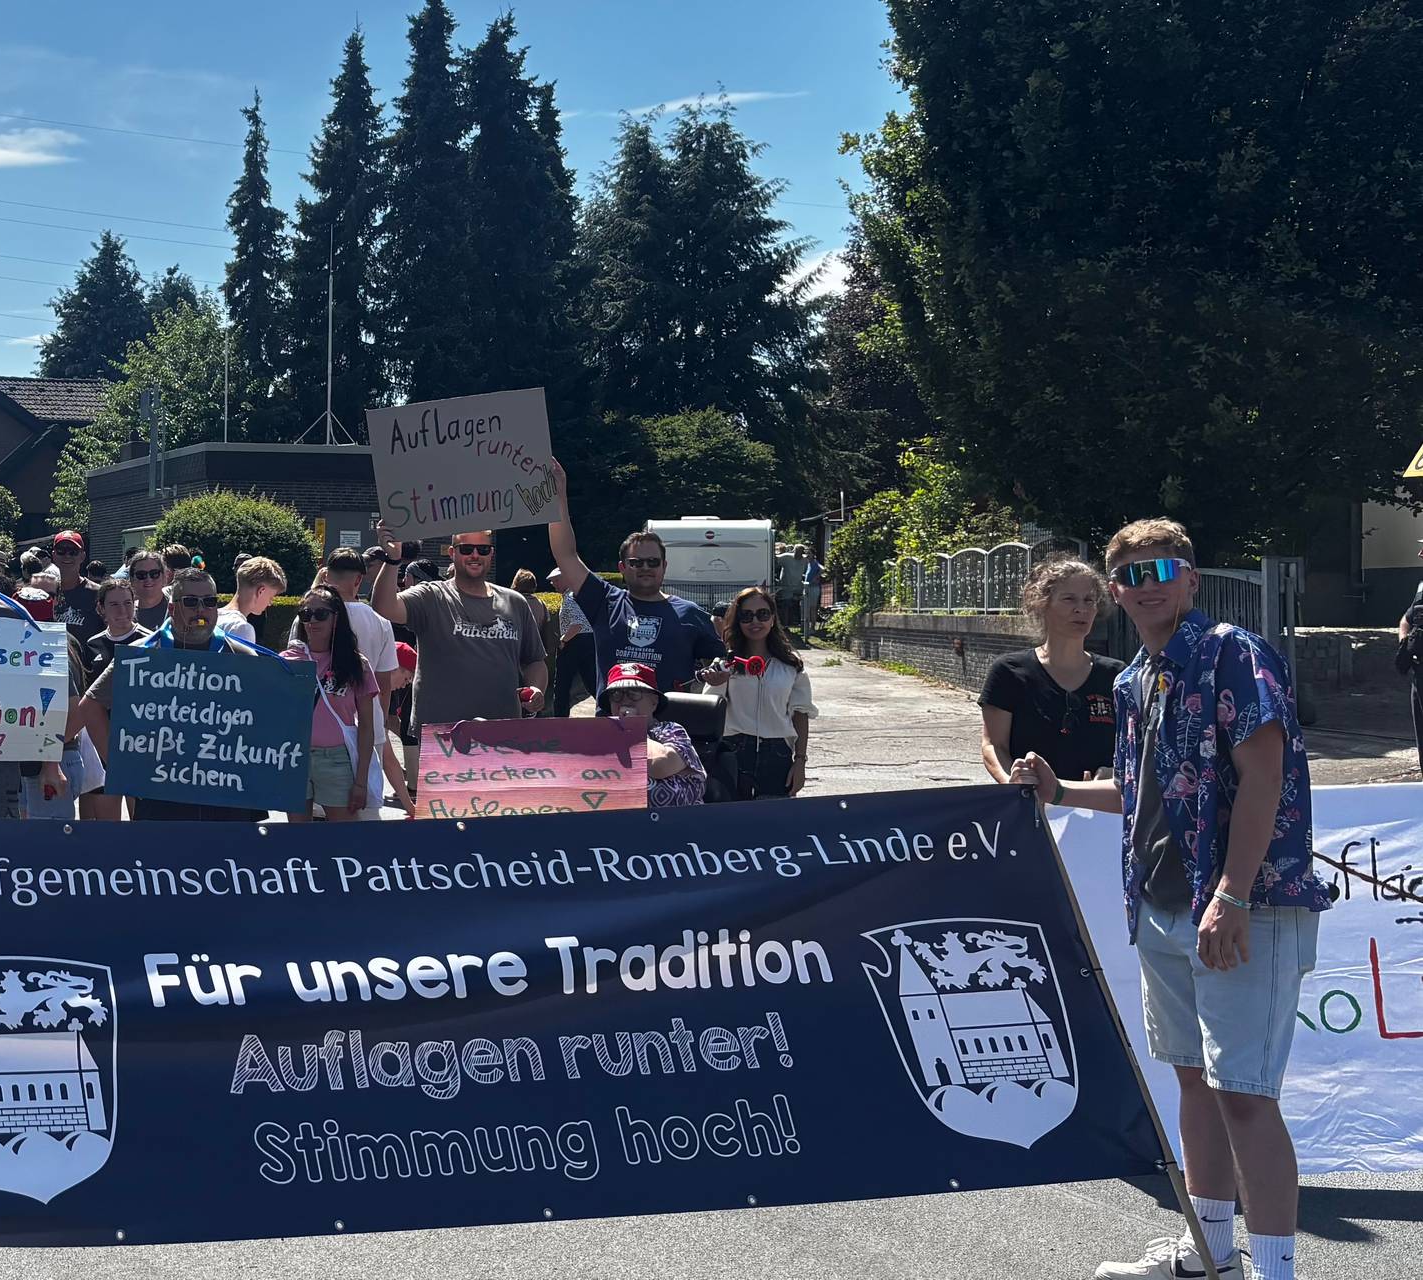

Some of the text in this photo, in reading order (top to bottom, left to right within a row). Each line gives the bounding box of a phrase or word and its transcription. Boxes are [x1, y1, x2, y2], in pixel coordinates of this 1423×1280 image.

[391, 408, 501, 455] Auflagen
[477, 439, 544, 476] runter
[388, 484, 514, 528] Stimmung
[121, 656, 243, 693] Tradition
[130, 695, 254, 735] verteidigen
[119, 726, 303, 771] heißt Zukunft
[150, 761, 245, 791] sichern
[424, 766, 622, 785] ersticken an
[331, 827, 934, 895] Pattscheid-Romberg-Linde
[947, 820, 1018, 861] e.V.
[143, 928, 834, 1009] Für unsere Tradition
[229, 1011, 794, 1100] Auflagen runter!
[254, 1094, 801, 1184] Stimmung hoch!
